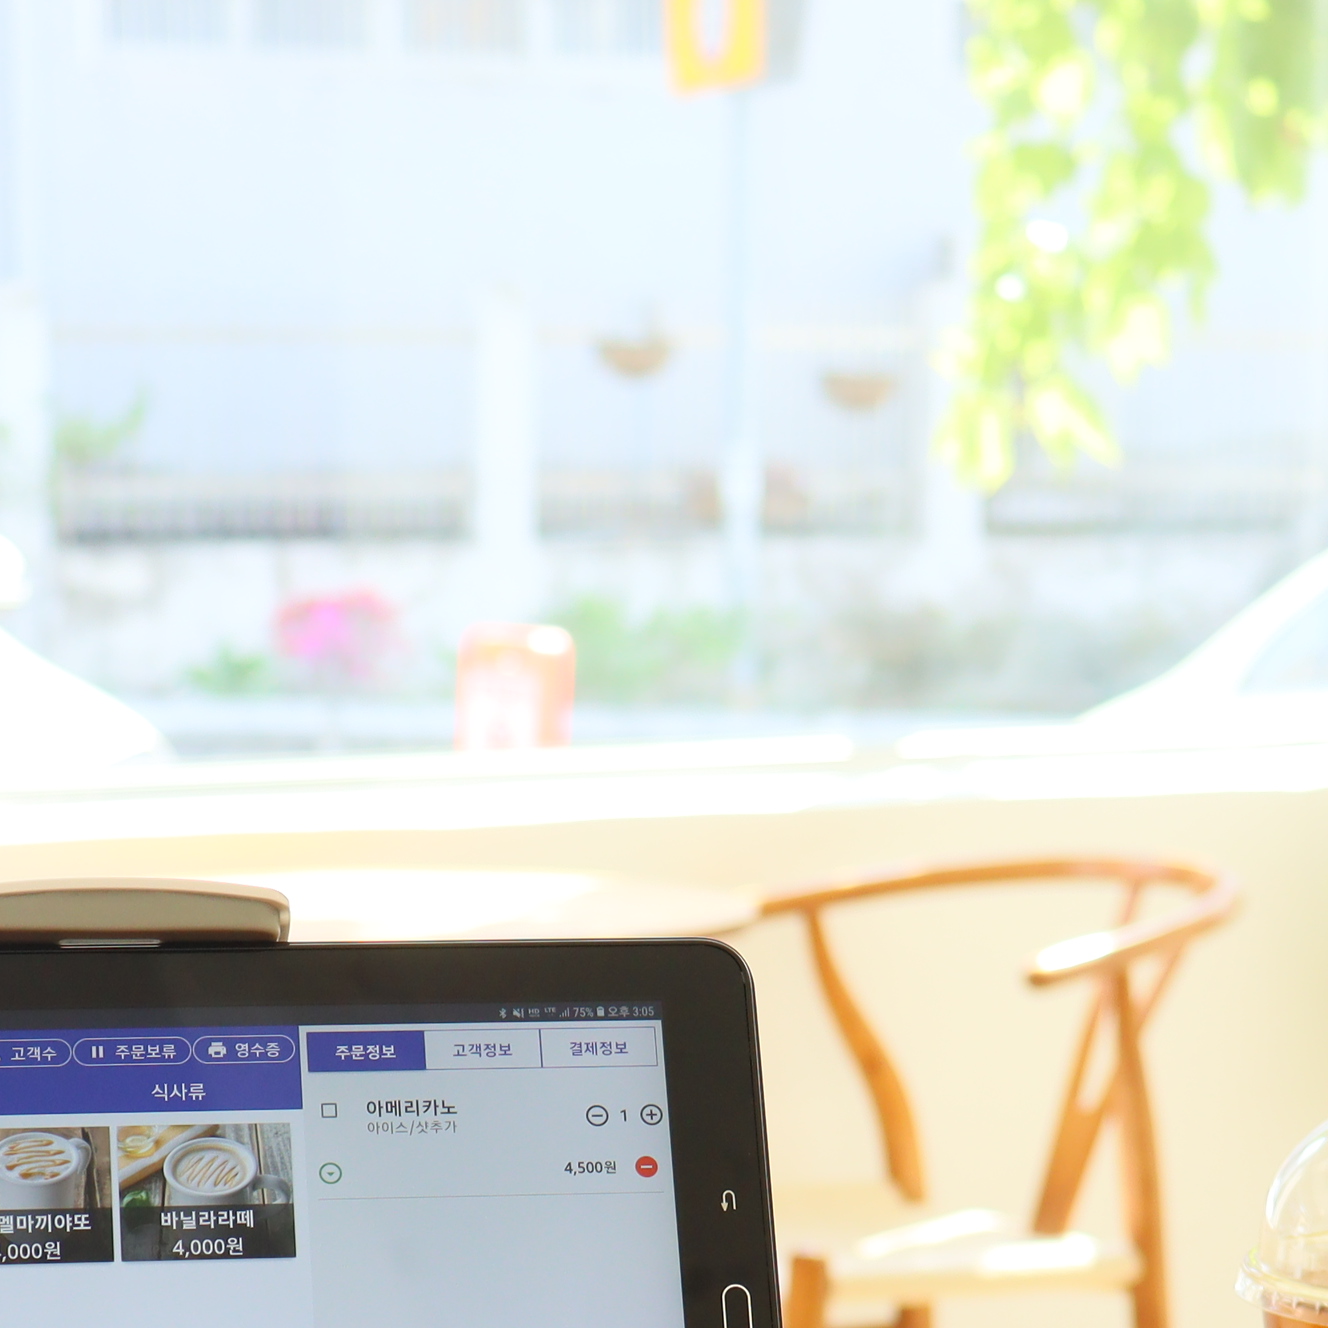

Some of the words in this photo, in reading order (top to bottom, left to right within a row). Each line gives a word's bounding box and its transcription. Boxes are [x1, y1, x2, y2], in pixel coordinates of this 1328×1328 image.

[573, 1007, 594, 1018] 75%
[608, 1006, 630, 1018] 오후
[633, 1006, 655, 1017] 3:05
[10, 1046, 58, 1062] 고객수
[115, 1043, 177, 1060] 주문보류
[235, 1042, 281, 1058] 영수증
[335, 1044, 397, 1061] 주문정보
[453, 1042, 513, 1058] 고객정보
[569, 1040, 629, 1057] 결제정보
[151, 1083, 207, 1102] 식사류
[366, 1099, 458, 1118] 아메리카노
[620, 1109, 627, 1122] 1
[367, 1120, 458, 1136] 아이스/샷추가
[564, 1160, 617, 1177] 4,500원
[160, 1209, 255, 1230] 바닐라라떼
[172, 1236, 244, 1259] 4,000원
